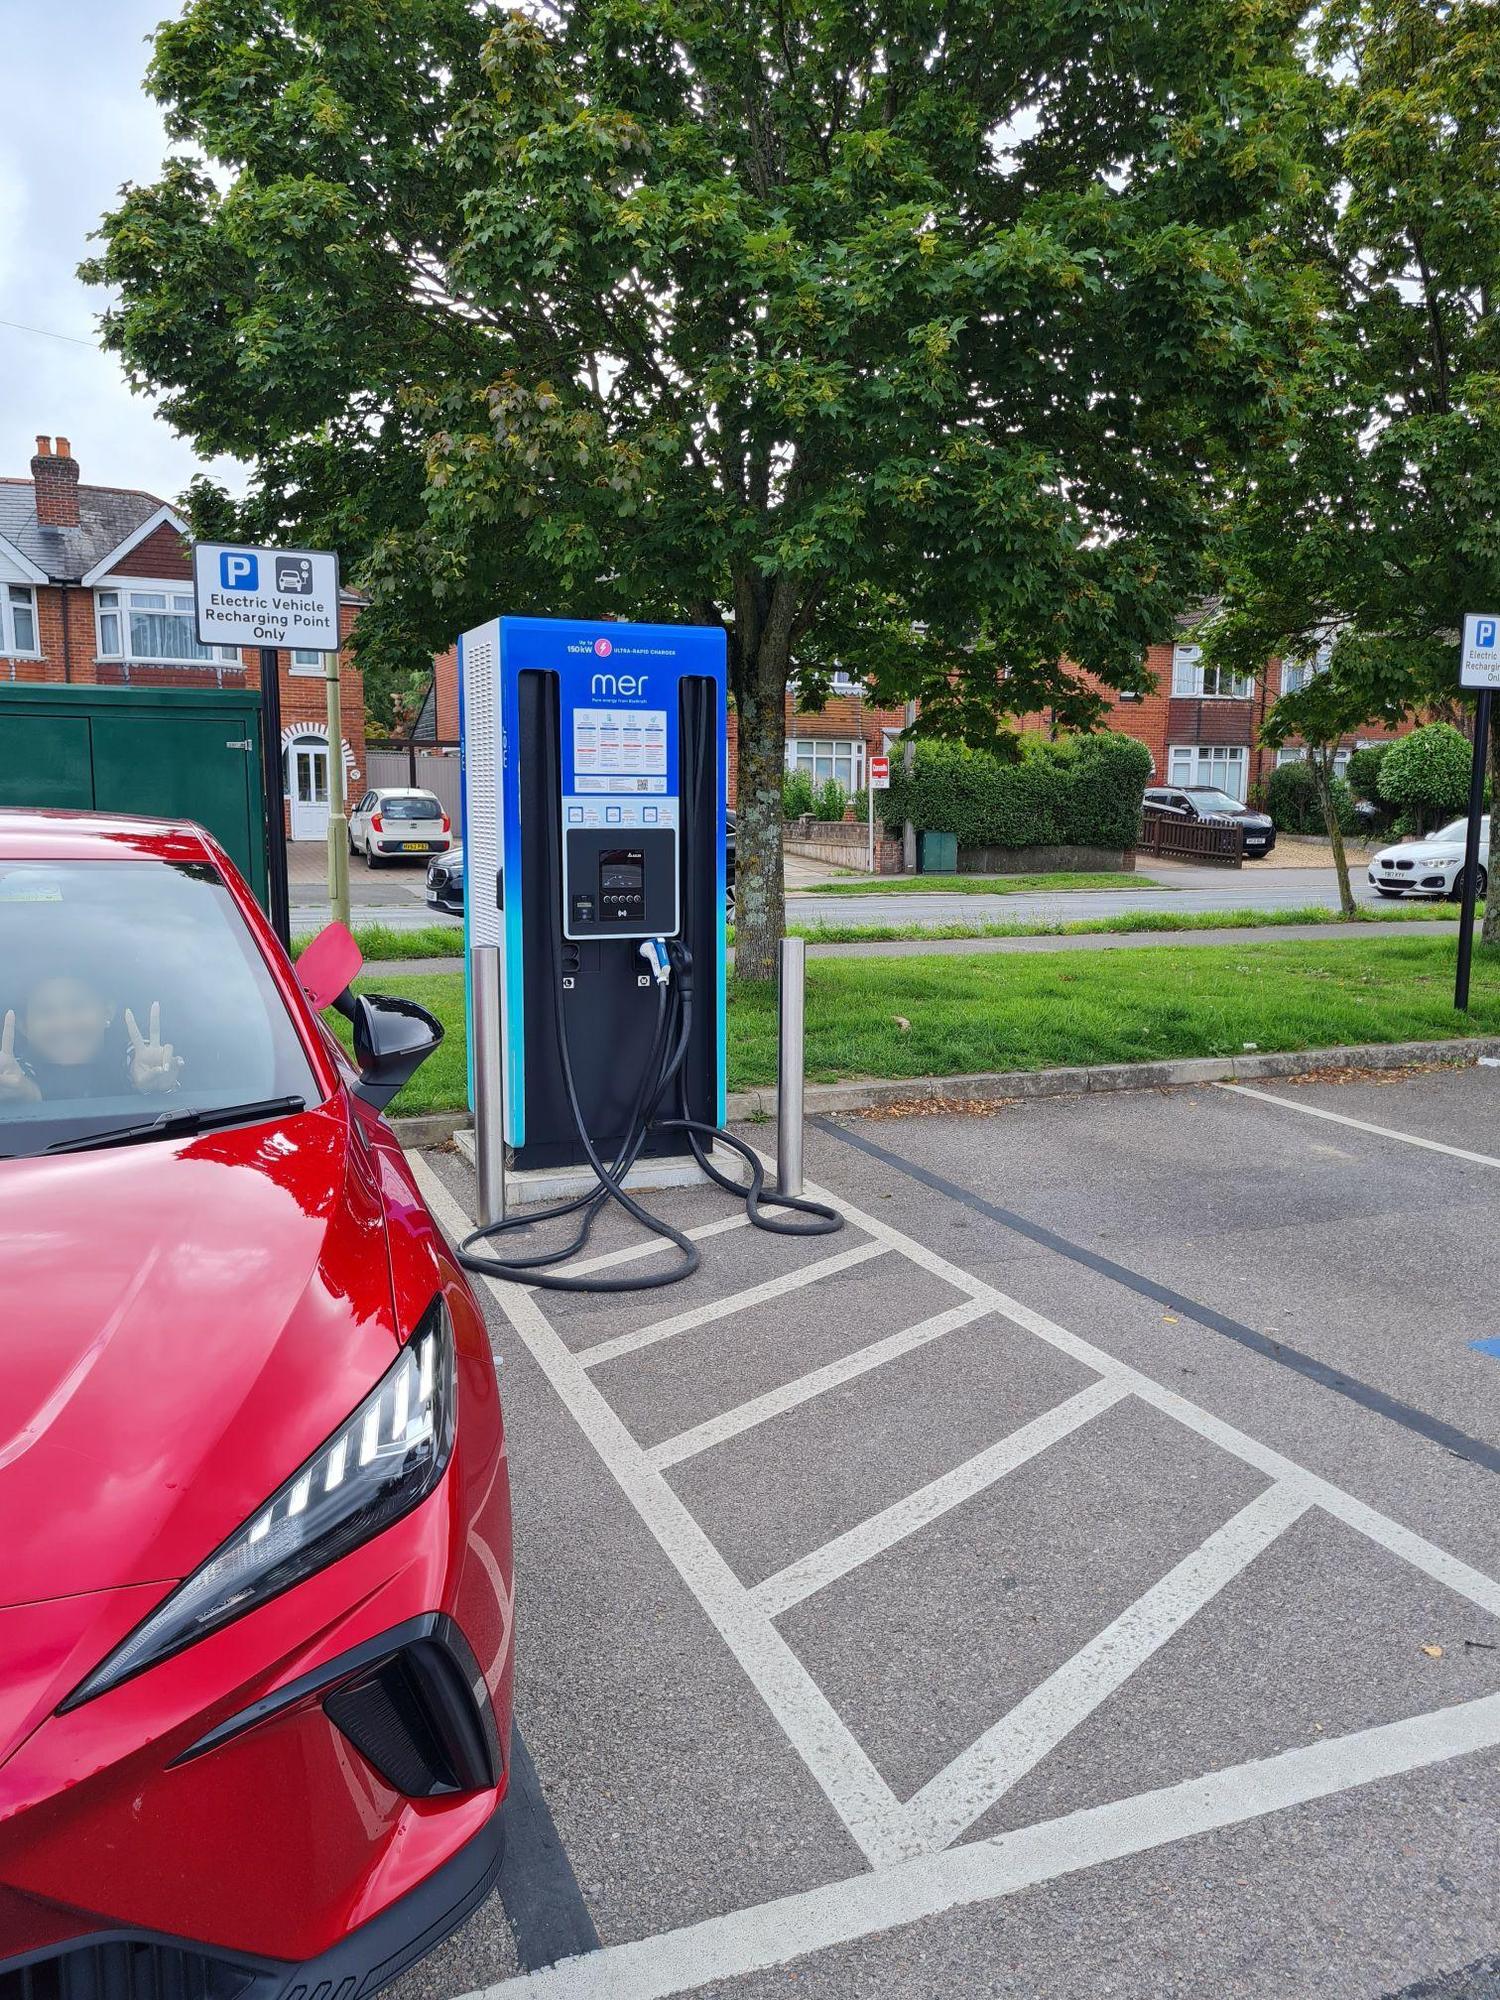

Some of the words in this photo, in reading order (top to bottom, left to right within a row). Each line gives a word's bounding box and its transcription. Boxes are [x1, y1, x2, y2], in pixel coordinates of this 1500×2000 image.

[227, 557, 251, 586] P
[210, 594, 268, 609] Electric
[272, 598, 324, 612] Vehicle
[205, 609, 288, 627] Recharging
[293, 614, 330, 628] Point
[253, 627, 286, 641] Only
[1479, 623, 1492, 645] P
[1469, 650, 1498, 660] Electric
[591, 673, 649, 696] mer
